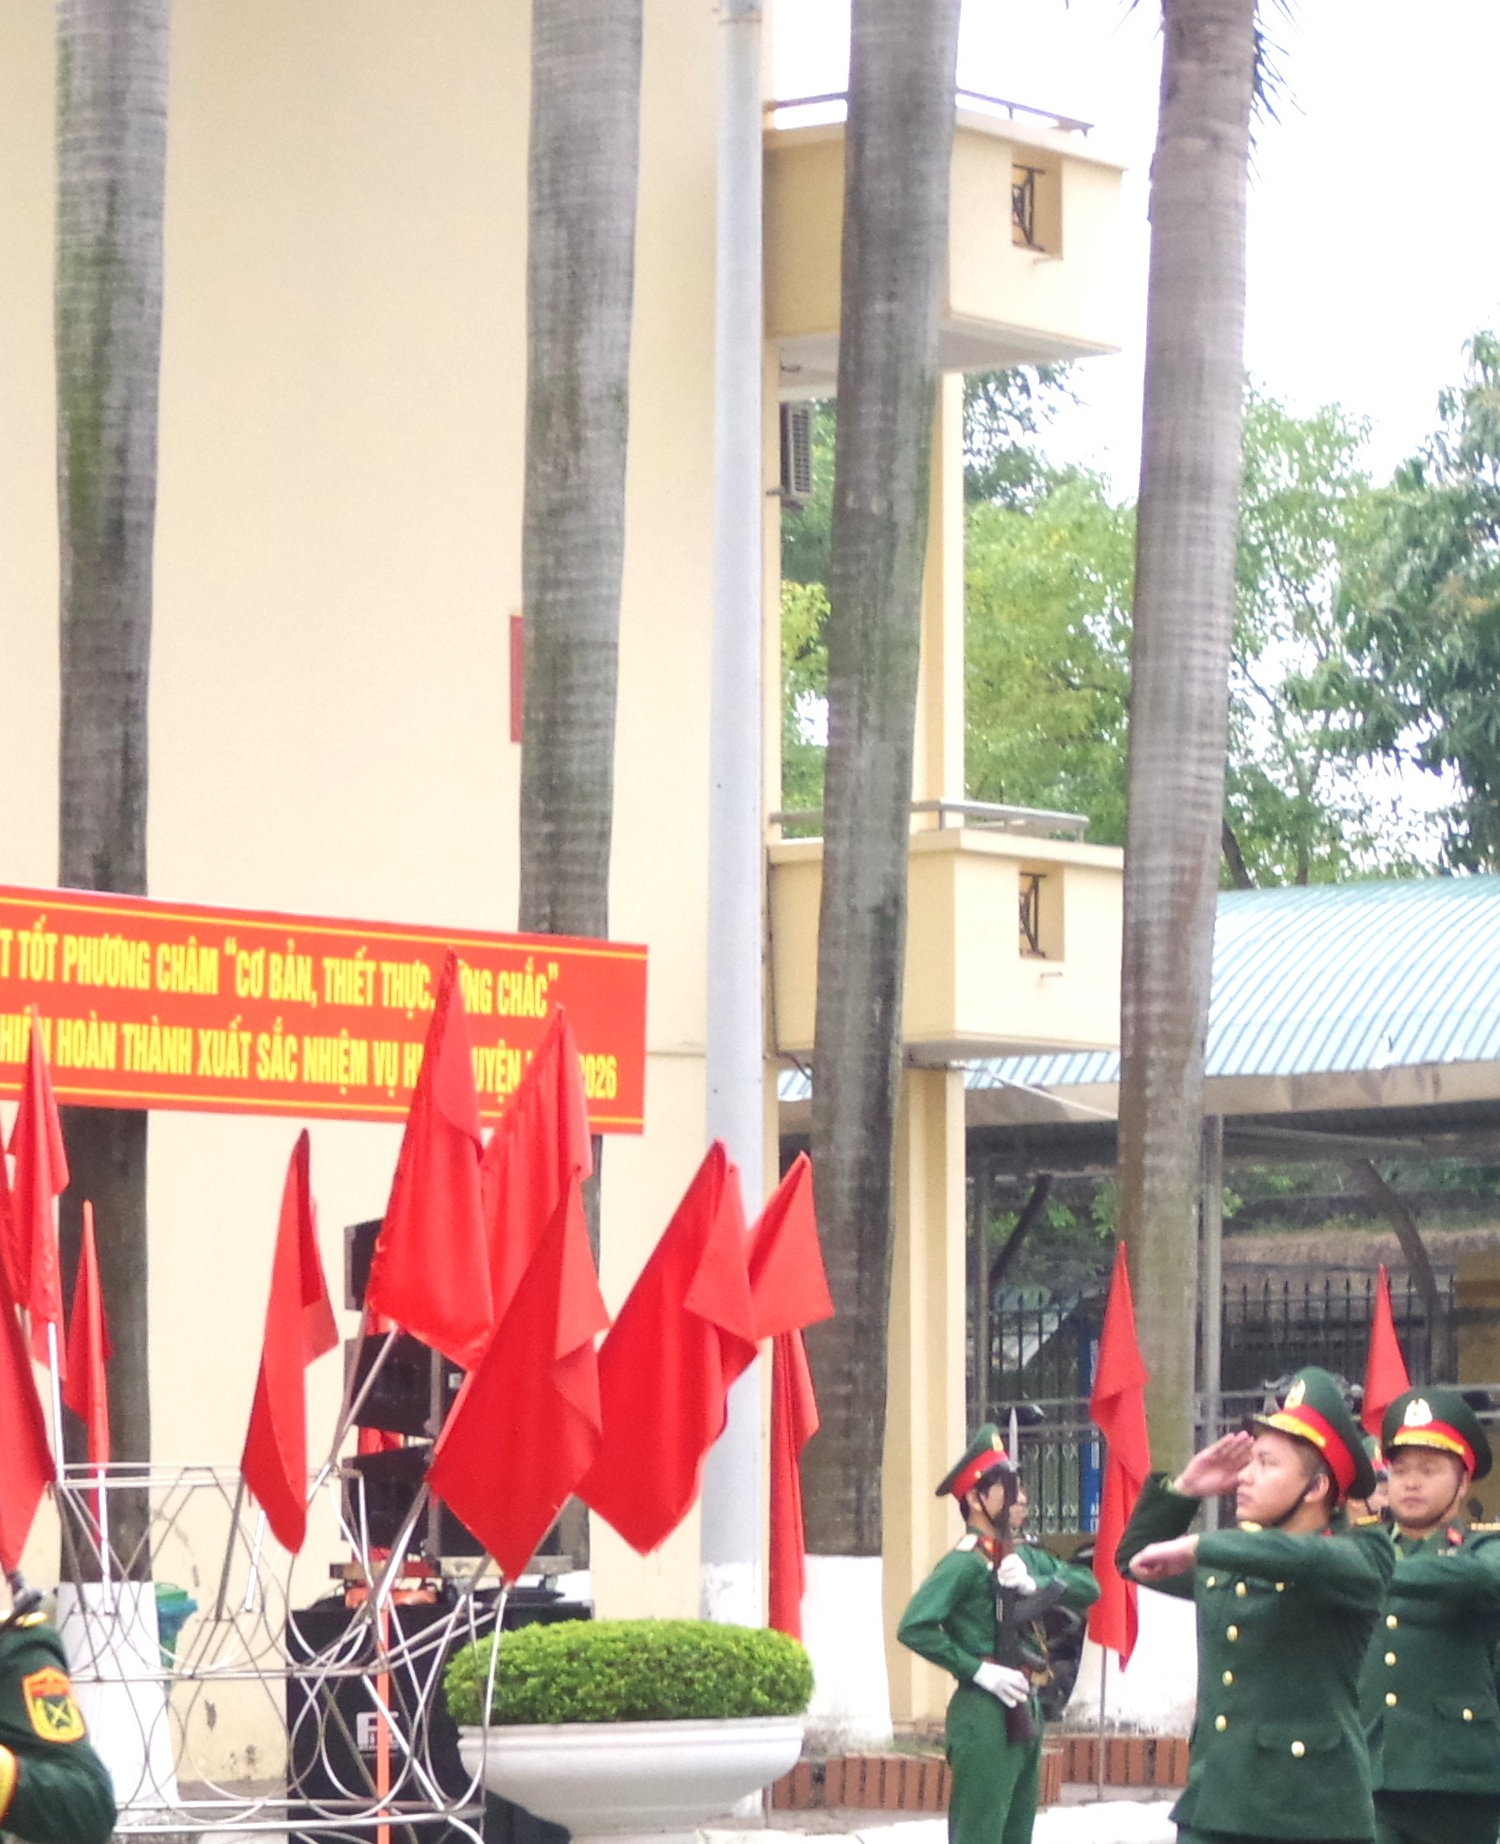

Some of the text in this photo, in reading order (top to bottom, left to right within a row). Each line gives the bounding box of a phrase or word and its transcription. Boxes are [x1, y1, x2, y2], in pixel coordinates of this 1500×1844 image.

[18, 916, 58, 981] TỐT
[63, 934, 150, 989] PHƯƠNG
[156, 936, 218, 994] CHÂM
[269, 940, 317, 1007] BẢN,
[323, 947, 376, 1005] THIẾT
[458, 960, 492, 1014] NG
[57, 1012, 116, 1069] HOÀN
[122, 1016, 192, 1074] THÀNH
[198, 1016, 252, 1078] XUẤT
[257, 1017, 298, 1081] SẮC
[303, 1029, 368, 1094] NHIỆM
[373, 1041, 398, 1096] VỤ
[472, 1040, 520, 1102] UYỆN
[579, 1055, 616, 1098] 026
